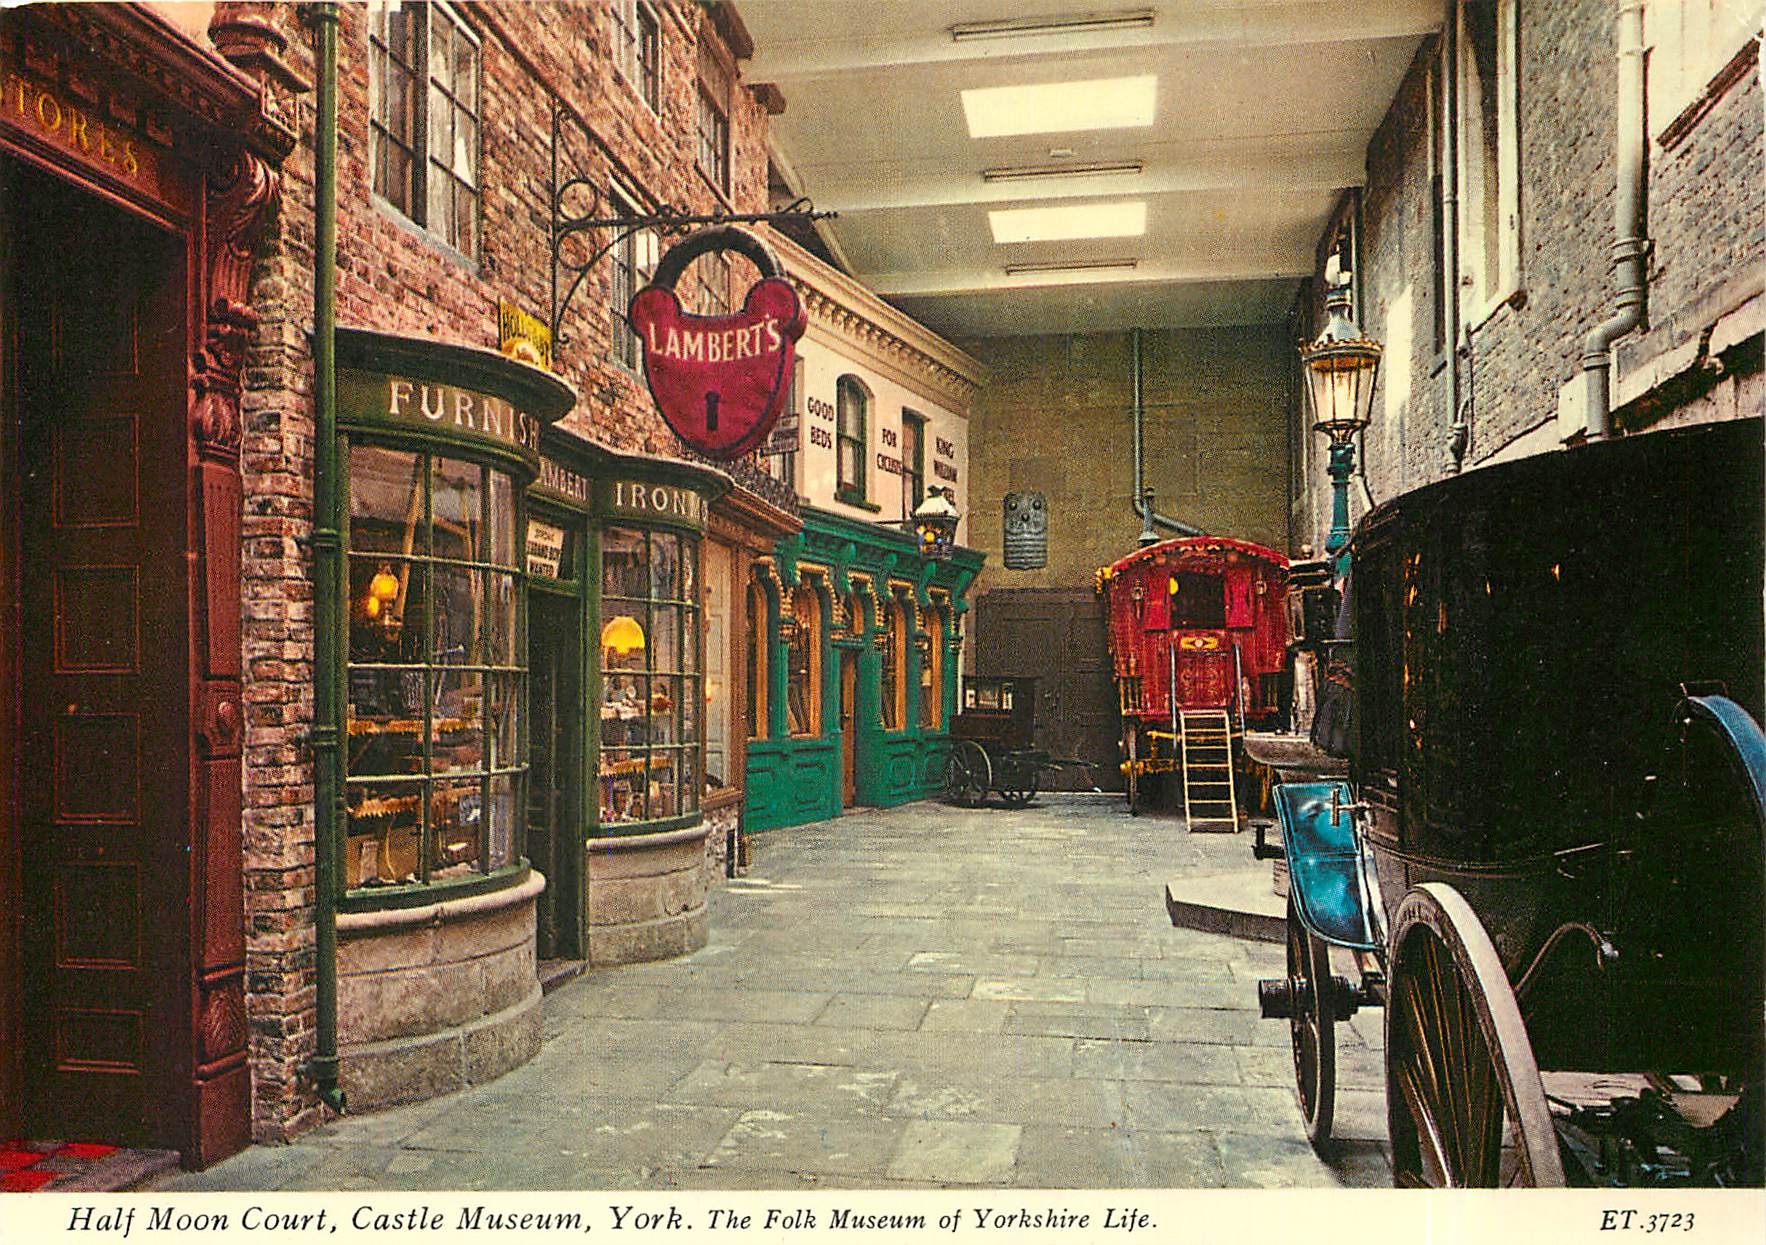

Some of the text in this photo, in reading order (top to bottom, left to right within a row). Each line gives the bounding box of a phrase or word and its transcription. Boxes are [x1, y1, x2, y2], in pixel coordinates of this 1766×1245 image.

[0, 73, 138, 177] TORES
[649, 313, 783, 363] LAMBERT'S
[388, 379, 541, 452] FURNISH
[808, 396, 834, 423] GOOD
[811, 426, 832, 450] BEDS
[882, 428, 897, 448] FOR
